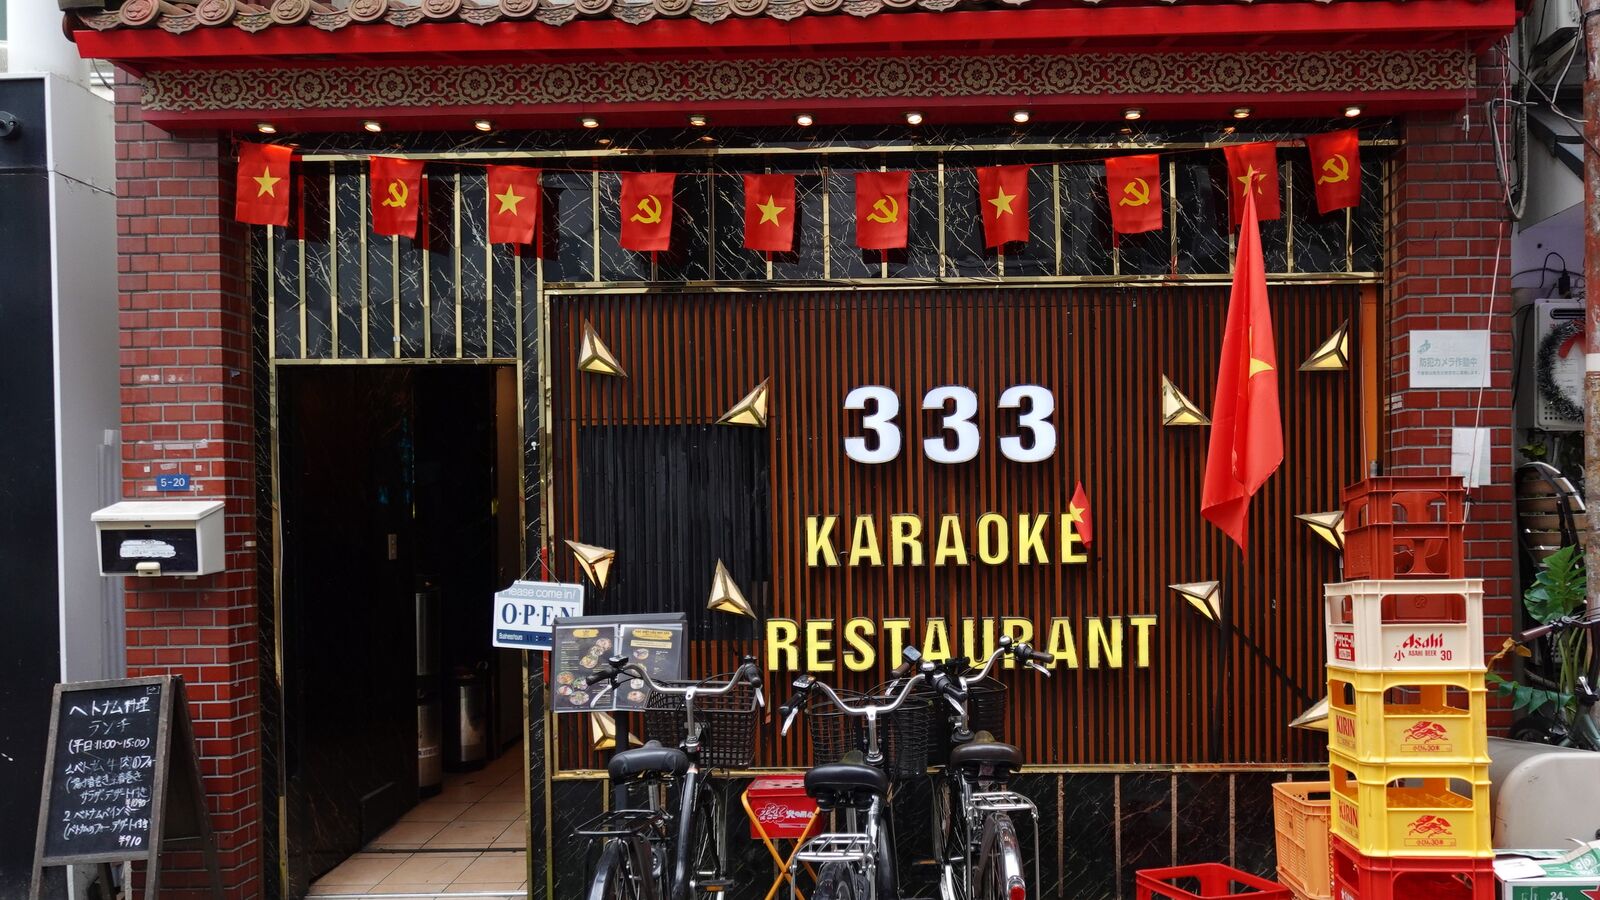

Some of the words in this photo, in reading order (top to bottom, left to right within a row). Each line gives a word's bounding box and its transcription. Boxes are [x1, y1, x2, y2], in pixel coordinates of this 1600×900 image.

[160, 478, 185, 487] 5-20
[806, 512, 1088, 567] KARAOKE
[535, 589, 562, 599] come
[765, 616, 1158, 673] RESTAURANT
[1402, 633, 1443, 648] Asahi
[1393, 650, 1405, 661] 小
[1440, 650, 1452, 661] 30
[89, 718, 131, 736] ランチ
[1336, 715, 1355, 737] KIRIN
[1339, 800, 1358, 826] KIRIN
[118, 835, 142, 847] ¥910
